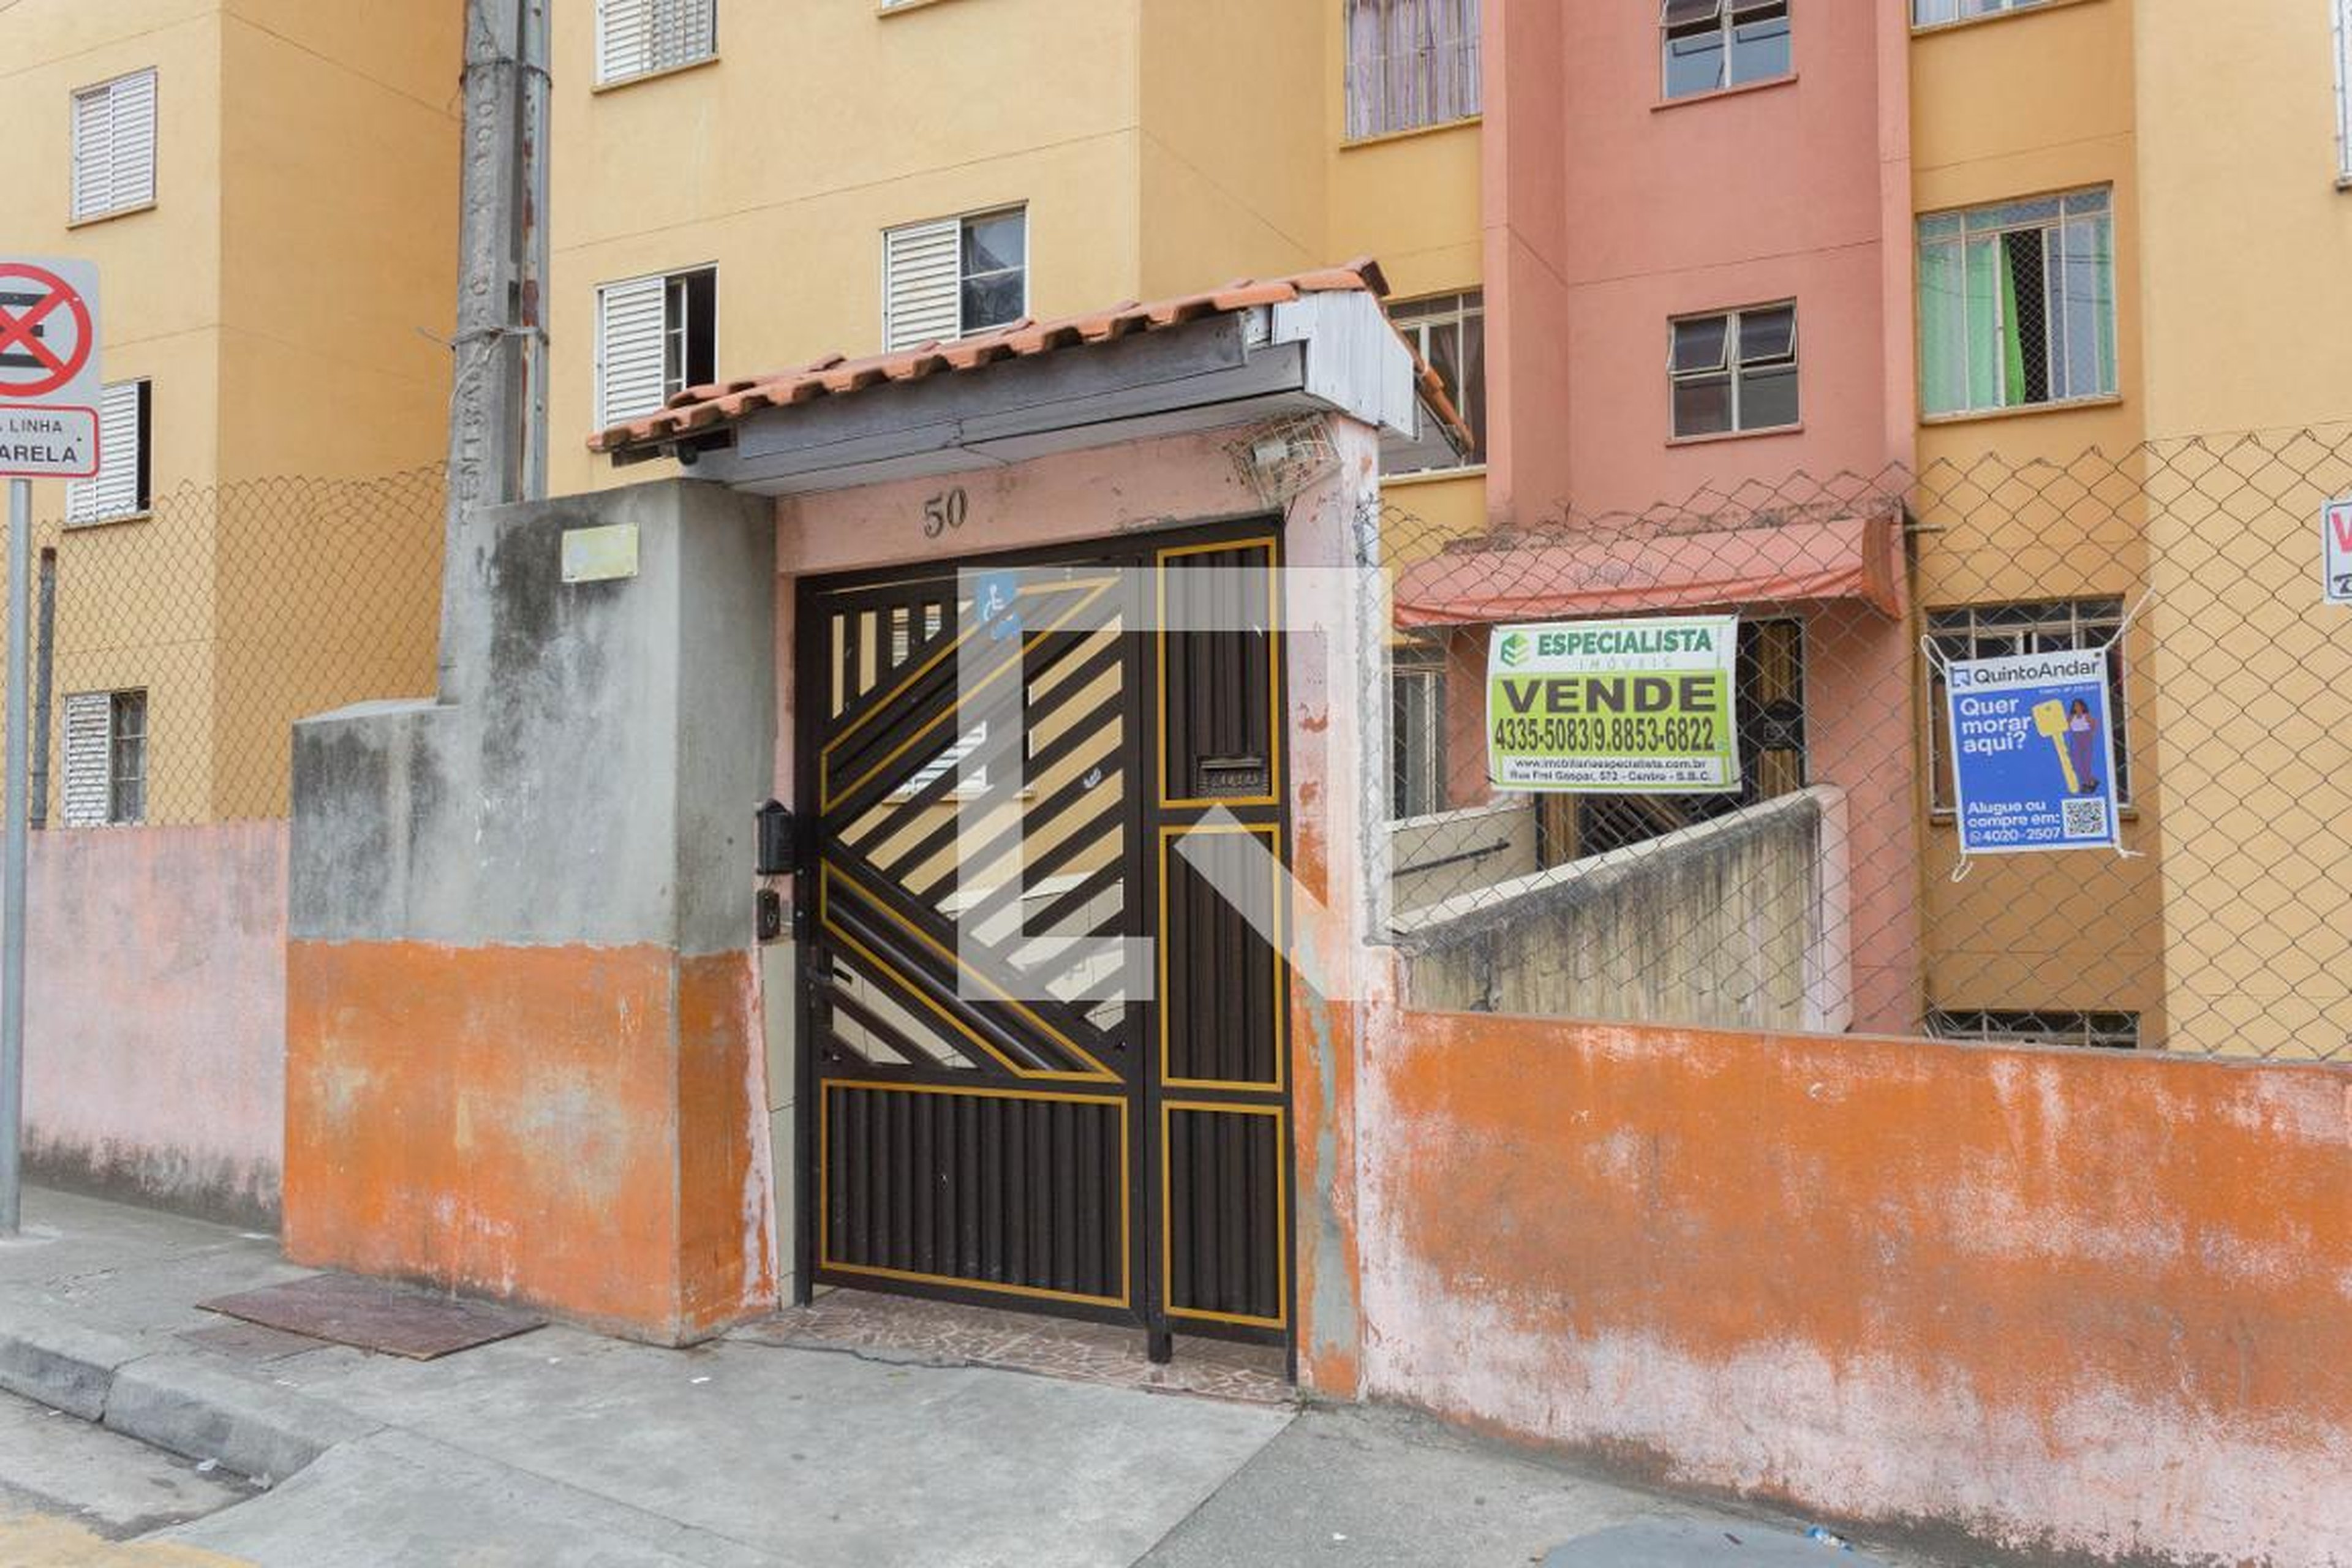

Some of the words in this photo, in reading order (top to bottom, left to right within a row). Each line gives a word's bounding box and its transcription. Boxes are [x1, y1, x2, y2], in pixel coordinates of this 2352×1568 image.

[9, 419, 62, 432] LINHA
[924, 487, 967, 538] 50
[1537, 629, 1713, 656] ESPECIALISTA
[1974, 660, 2098, 684] QuintoAndar
[1502, 677, 1716, 714] VENDE
[1960, 697, 2019, 715] Quer
[1962, 715, 2031, 734] morar
[1963, 732, 2027, 756] aqui?
[1628, 771, 1667, 781] Centro
[1967, 801, 2022, 815] Alugue
[2026, 801, 2046, 812] ou
[1967, 815, 2028, 829] compre
[2031, 813, 2060, 825] em:
